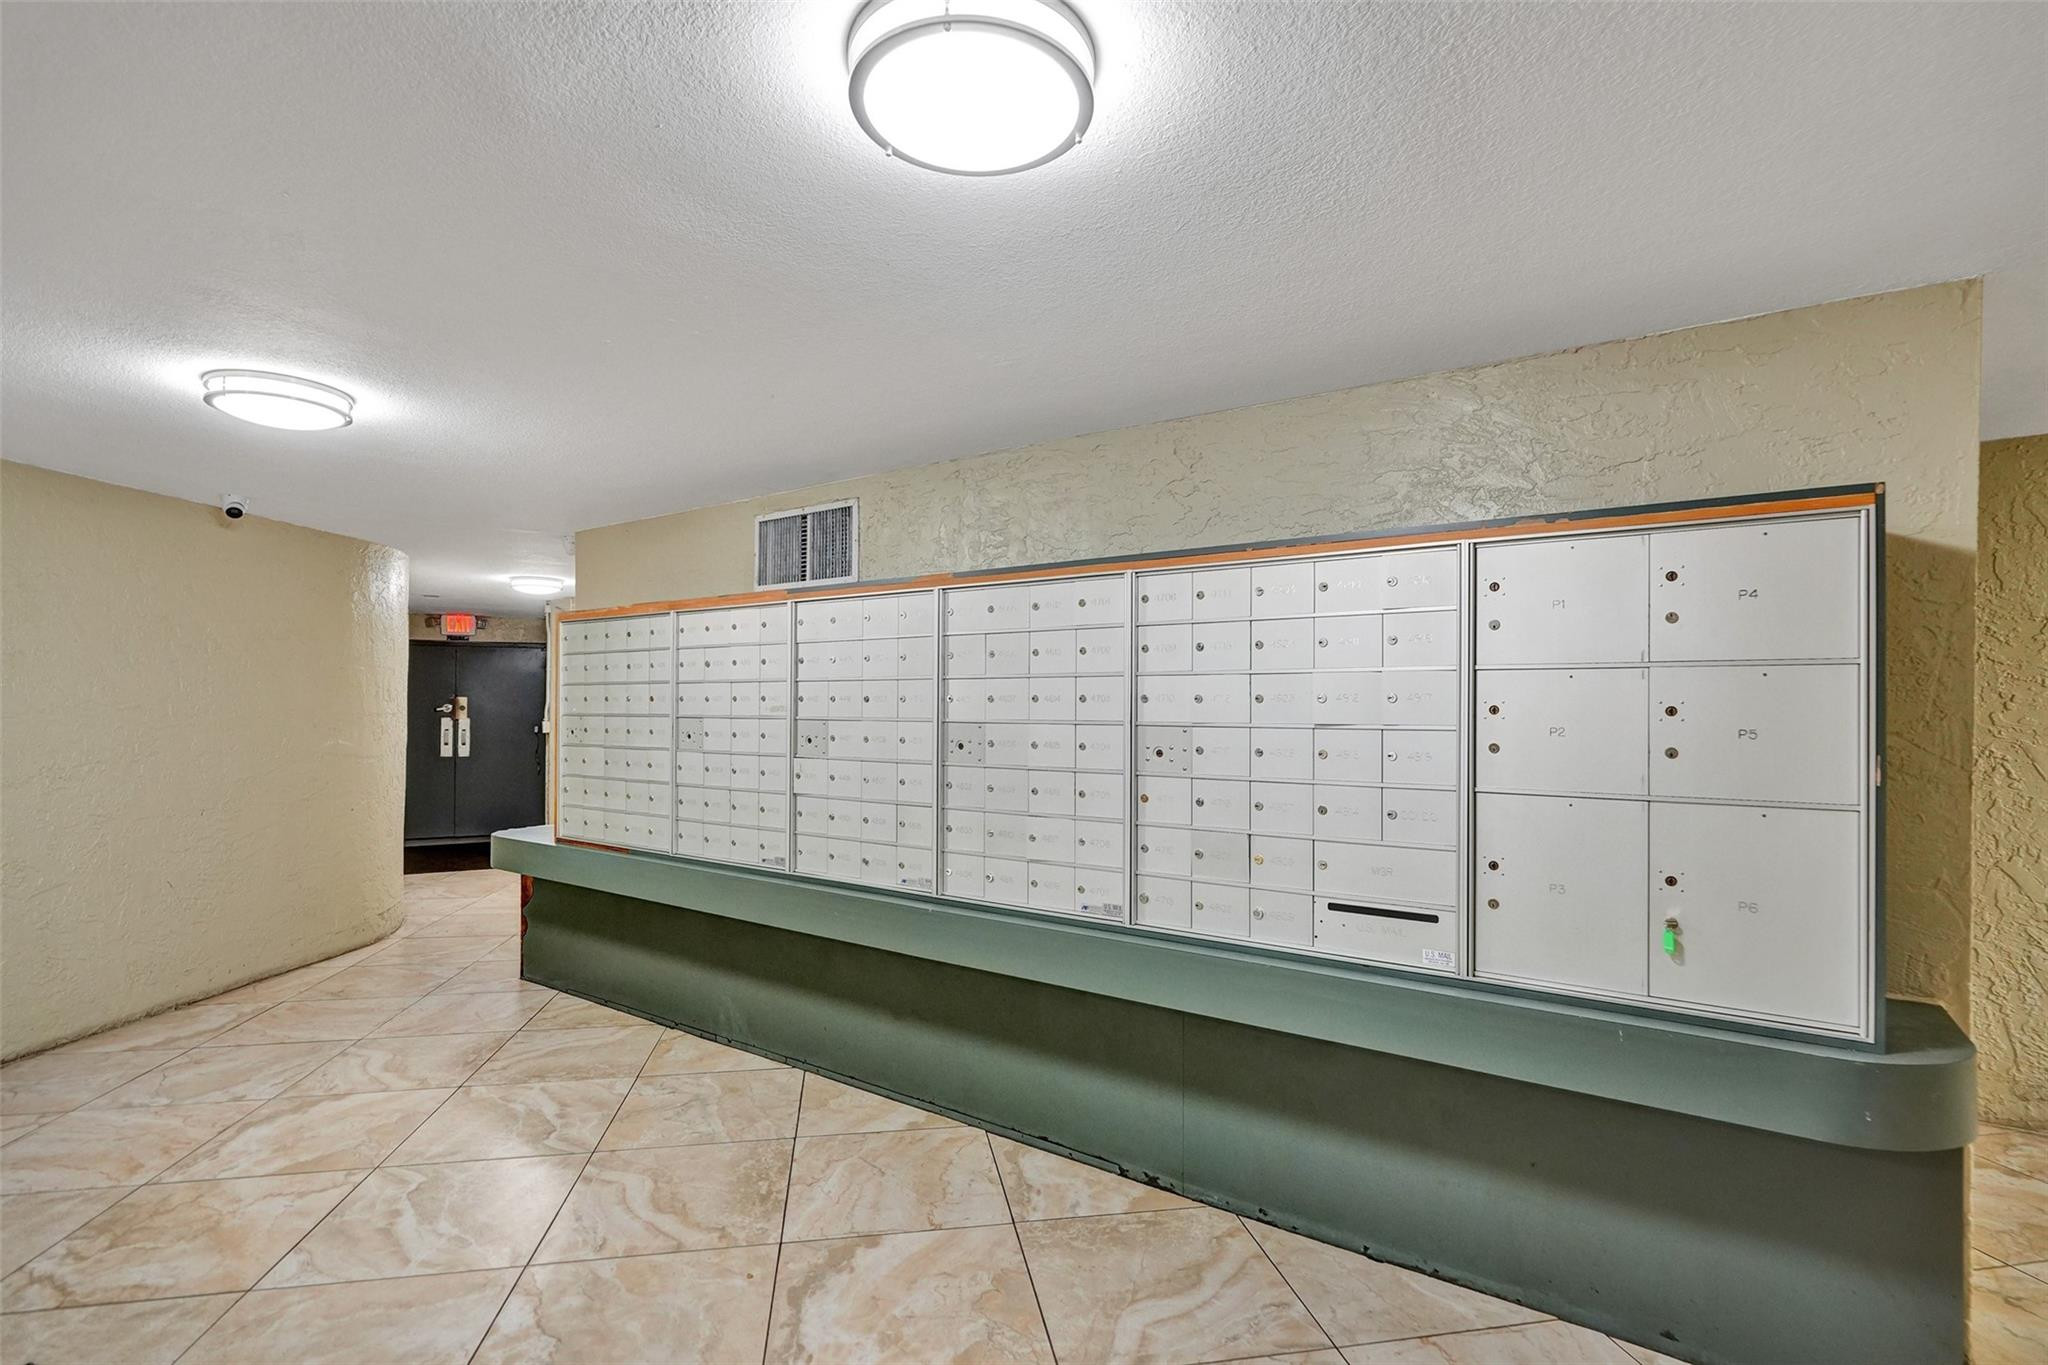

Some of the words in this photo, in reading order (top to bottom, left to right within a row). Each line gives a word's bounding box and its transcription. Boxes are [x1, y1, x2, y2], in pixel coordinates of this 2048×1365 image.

[1738, 588, 1759, 600] P4
[1551, 599, 1566, 609] P1
[447, 615, 471, 632] EXIT
[1549, 727, 1566, 737] P2
[1737, 728, 1759, 740] P5
[1549, 884, 1566, 894] P3
[1738, 902, 1759, 914] P6
[1438, 952, 1453, 960] MAIL
